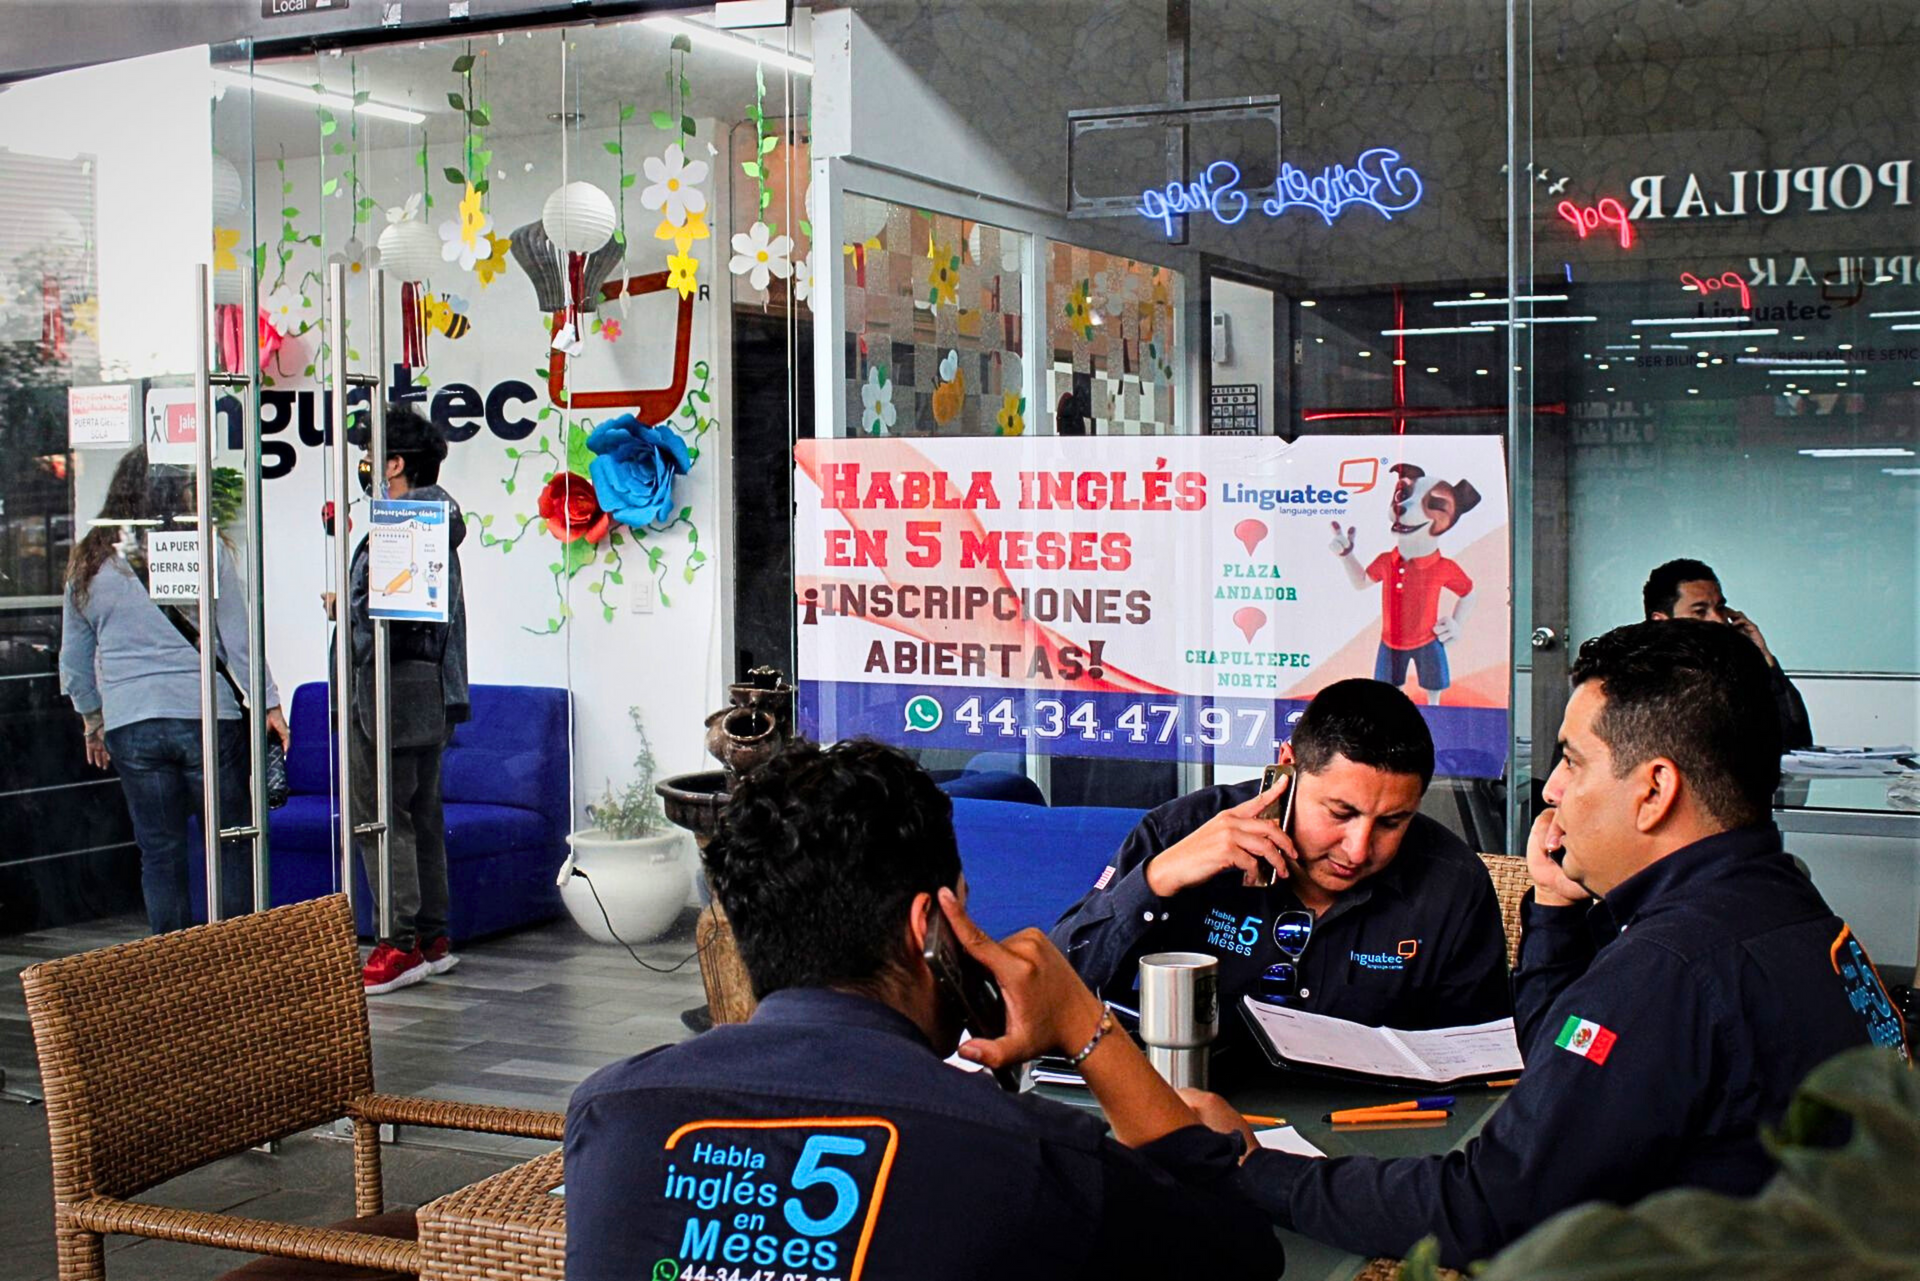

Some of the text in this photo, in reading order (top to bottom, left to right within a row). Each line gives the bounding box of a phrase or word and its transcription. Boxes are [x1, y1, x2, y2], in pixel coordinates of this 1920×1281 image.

[272, 0, 307, 14] Local
[1019, 457, 1207, 512] INGLÉS
[1222, 483, 1349, 511] Linguatec
[1279, 506, 1347, 516] language center
[155, 541, 199, 552] LA PUERT
[824, 521, 1132, 571] EN 5 MESES
[150, 562, 199, 573] CIERRA SO
[1223, 564, 1281, 578] PLAZA
[156, 584, 199, 594] NO FORZ
[1214, 586, 1297, 601] ANDADOR
[803, 584, 1152, 625] ¡INSCRIPCIONES
[864, 640, 1106, 681] ABIERTAS!
[1185, 650, 1310, 667] CHAPULTEPEC
[1217, 673, 1277, 688] NORTE
[954, 695, 1304, 746] 44.34.47.97.
[1223, 932, 1234, 940] en
[1238, 916, 1263, 945] 5
[1207, 931, 1252, 956] Meses
[693, 1143, 766, 1169] Habla
[665, 1135, 866, 1237] inglés 5
[733, 1213, 766, 1231] en
[679, 1217, 838, 1271] Meses
